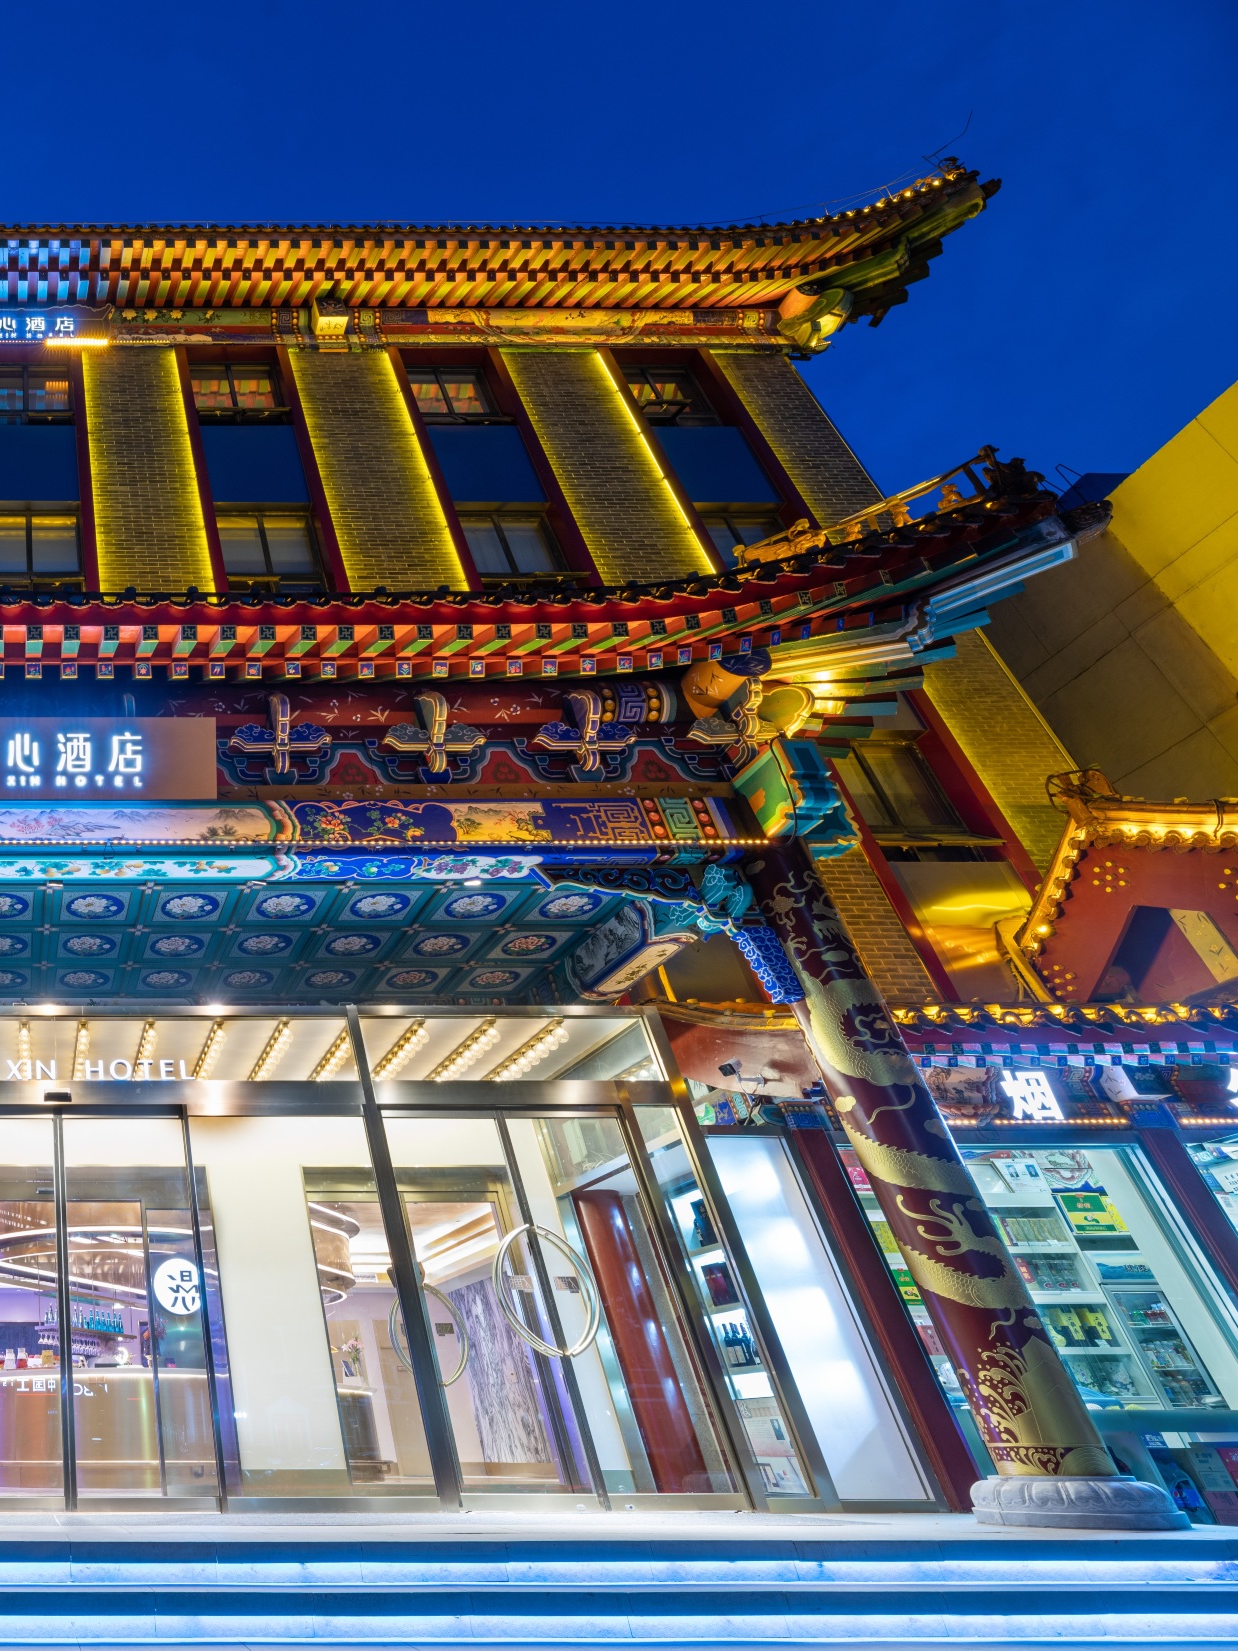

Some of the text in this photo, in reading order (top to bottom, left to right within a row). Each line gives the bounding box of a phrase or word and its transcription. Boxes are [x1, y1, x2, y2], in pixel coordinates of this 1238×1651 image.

[7, 775, 41, 787] XIN
[56, 775, 143, 787] HOTEL
[6, 1059, 57, 1080] XIN
[85, 1059, 196, 1080] HOTEL
[1000, 1070, 1064, 1120] 烟
